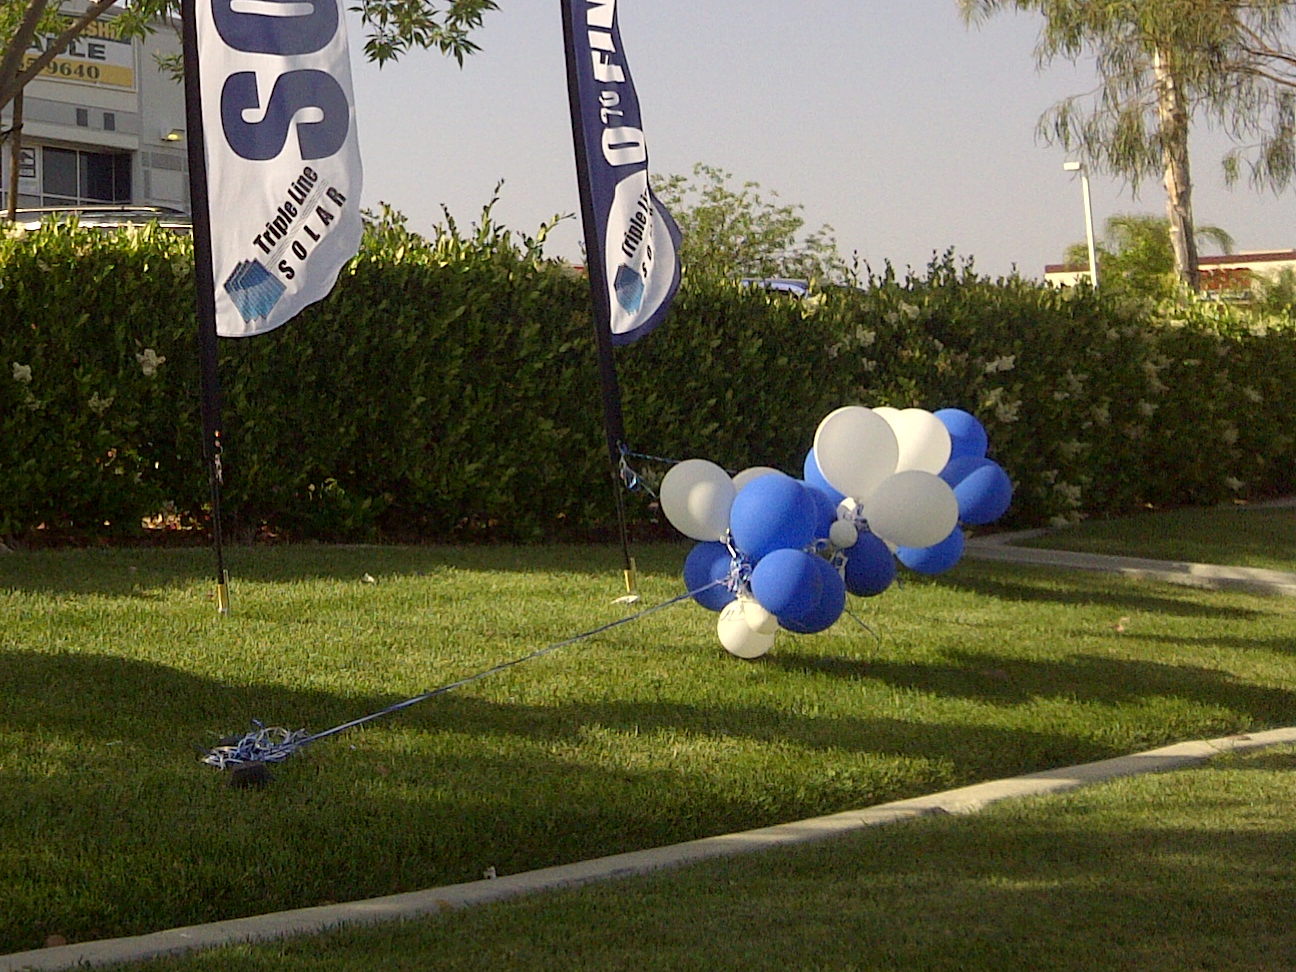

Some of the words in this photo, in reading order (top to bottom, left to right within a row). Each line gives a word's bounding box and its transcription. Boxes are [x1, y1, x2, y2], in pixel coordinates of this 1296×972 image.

[253, 201, 298, 254] Triple
[287, 166, 319, 206] Line
[278, 186, 347, 280] SOLAR
